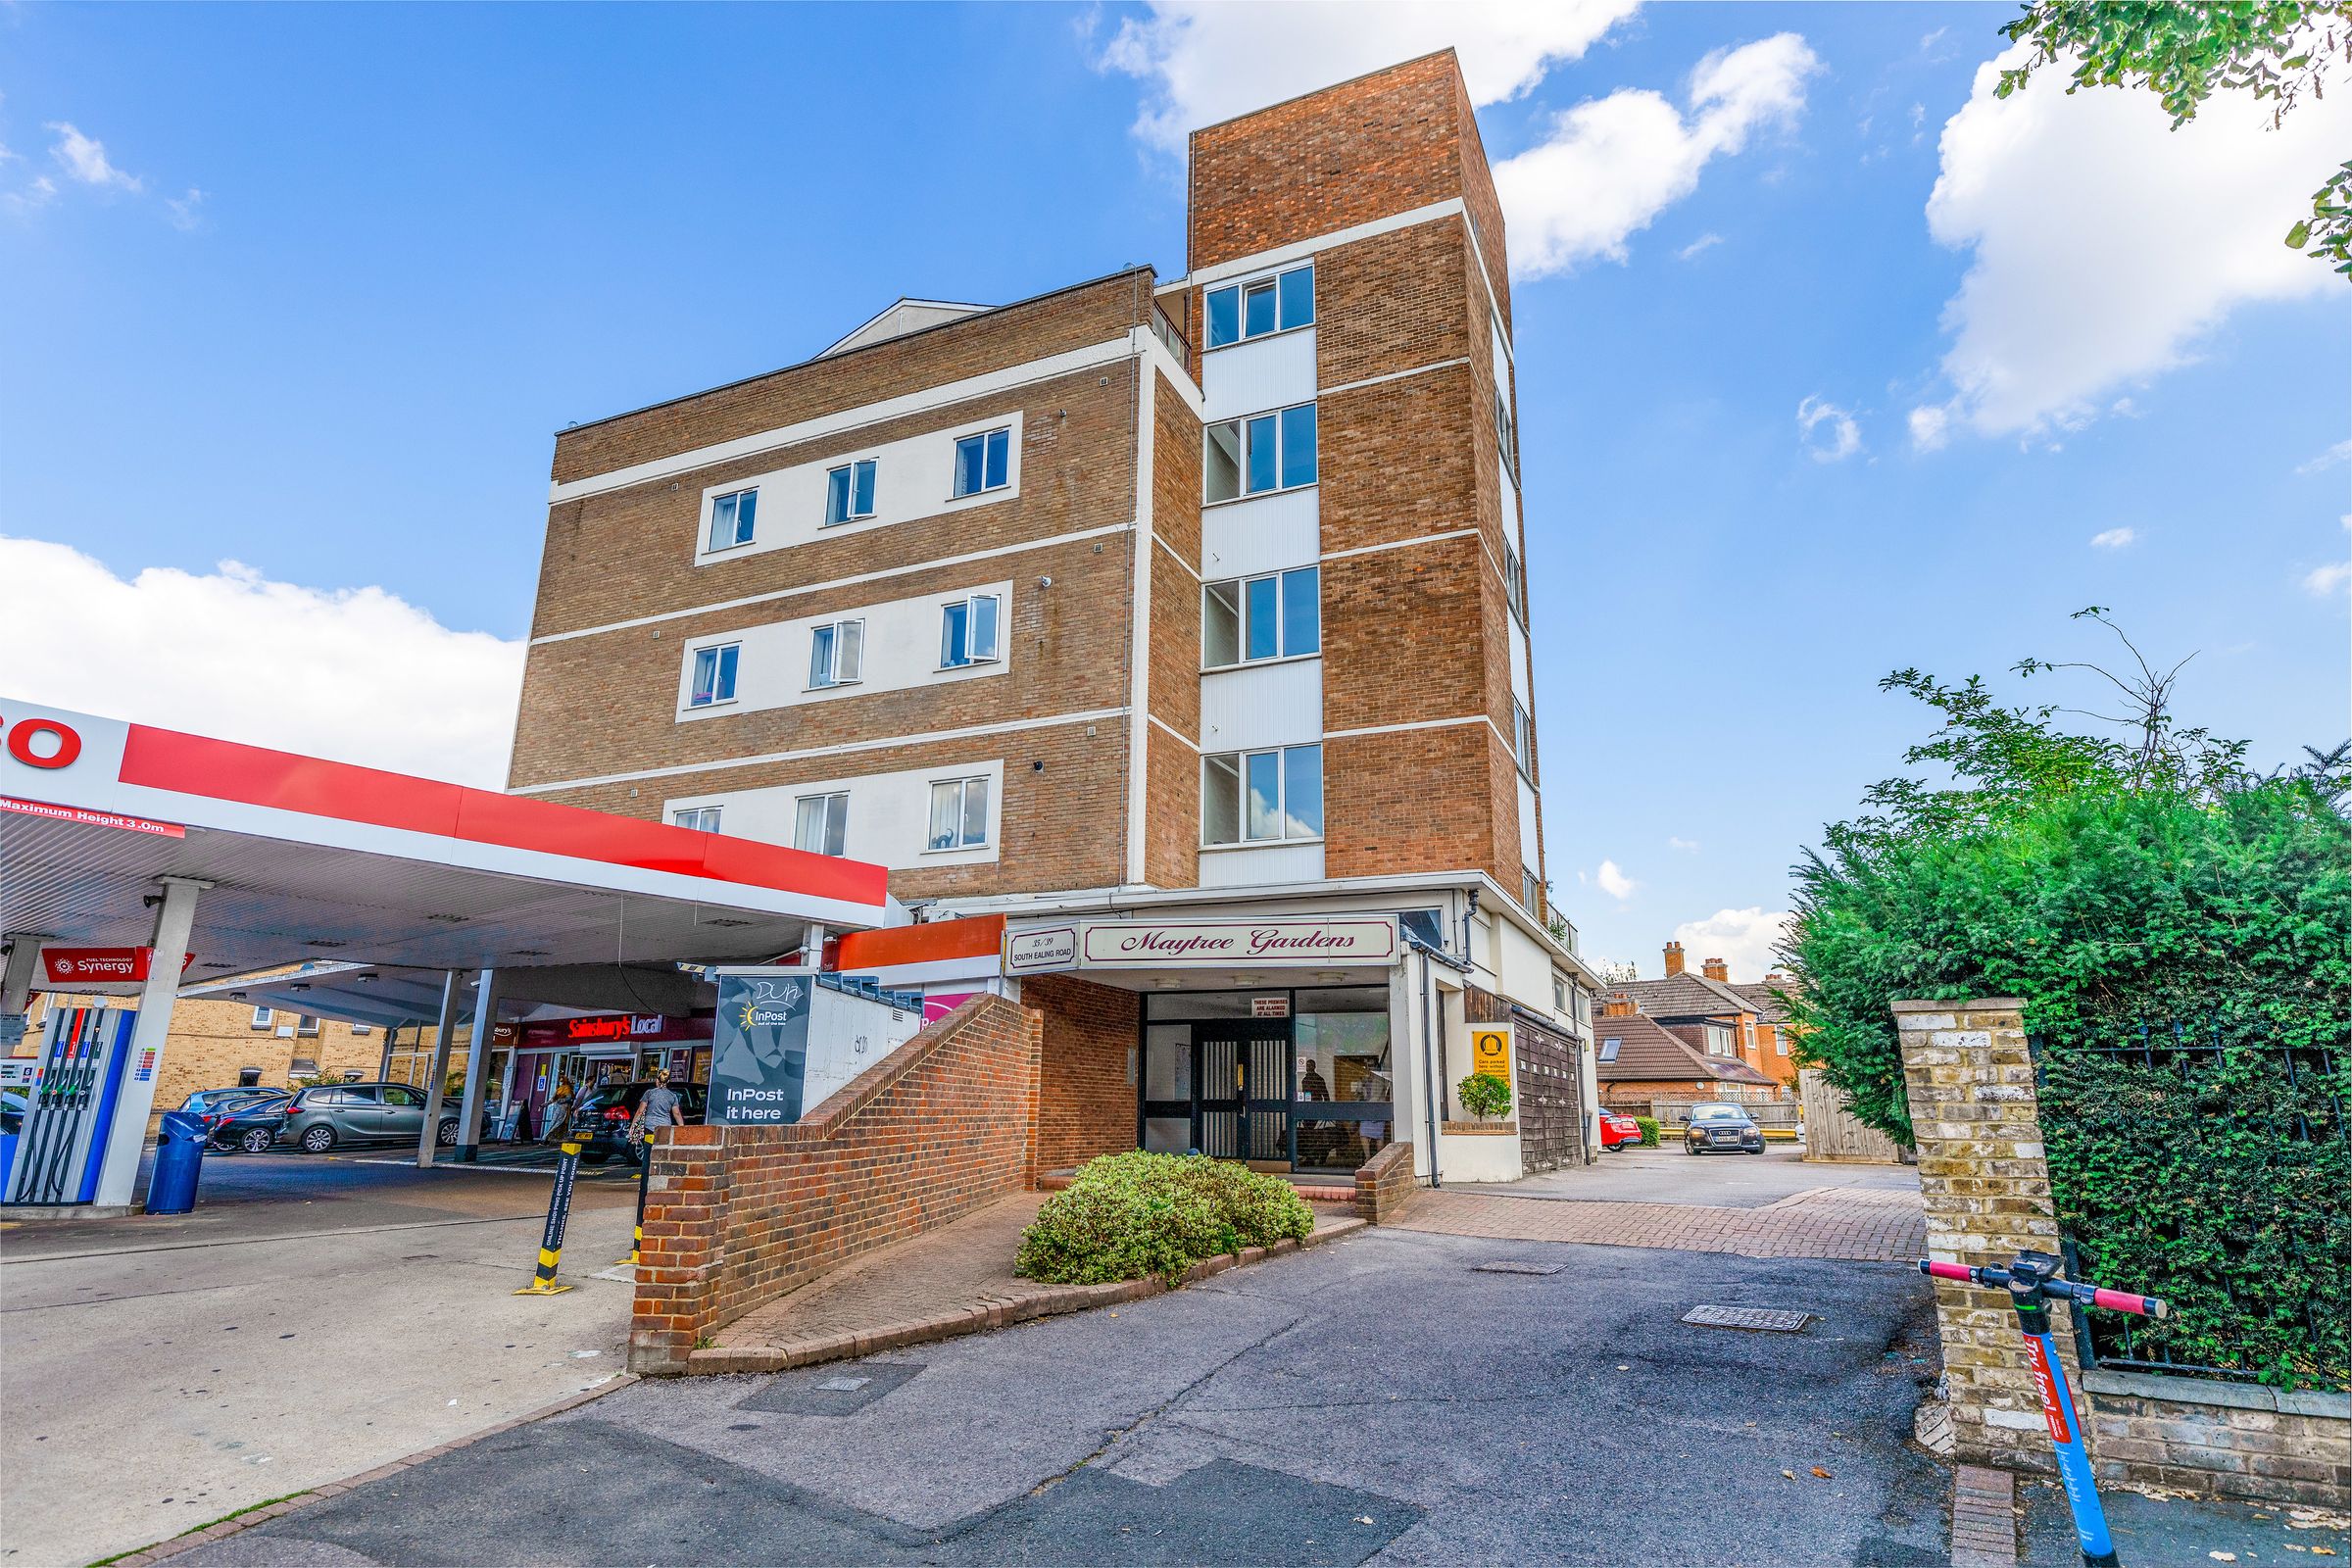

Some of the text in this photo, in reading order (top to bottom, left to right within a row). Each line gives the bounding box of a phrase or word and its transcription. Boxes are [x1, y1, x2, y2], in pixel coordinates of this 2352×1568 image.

[0, 800, 73, 818] Maximum
[76, 811, 124, 826] Height
[1032, 938, 1054, 948] 35/39
[1120, 929, 1355, 956] Maytree Gardens
[1034, 951, 1054, 959] EALING
[1055, 948, 1072, 956] ROAD
[77, 960, 134, 974] Synergy
[756, 1011, 787, 1021] InPost
[567, 1015, 631, 1040] Sainsbury's
[630, 1013, 664, 1035] Local
[727, 1088, 784, 1102] InPost
[726, 1105, 782, 1119] it here
[2026, 1341, 2057, 1411] Try free!
